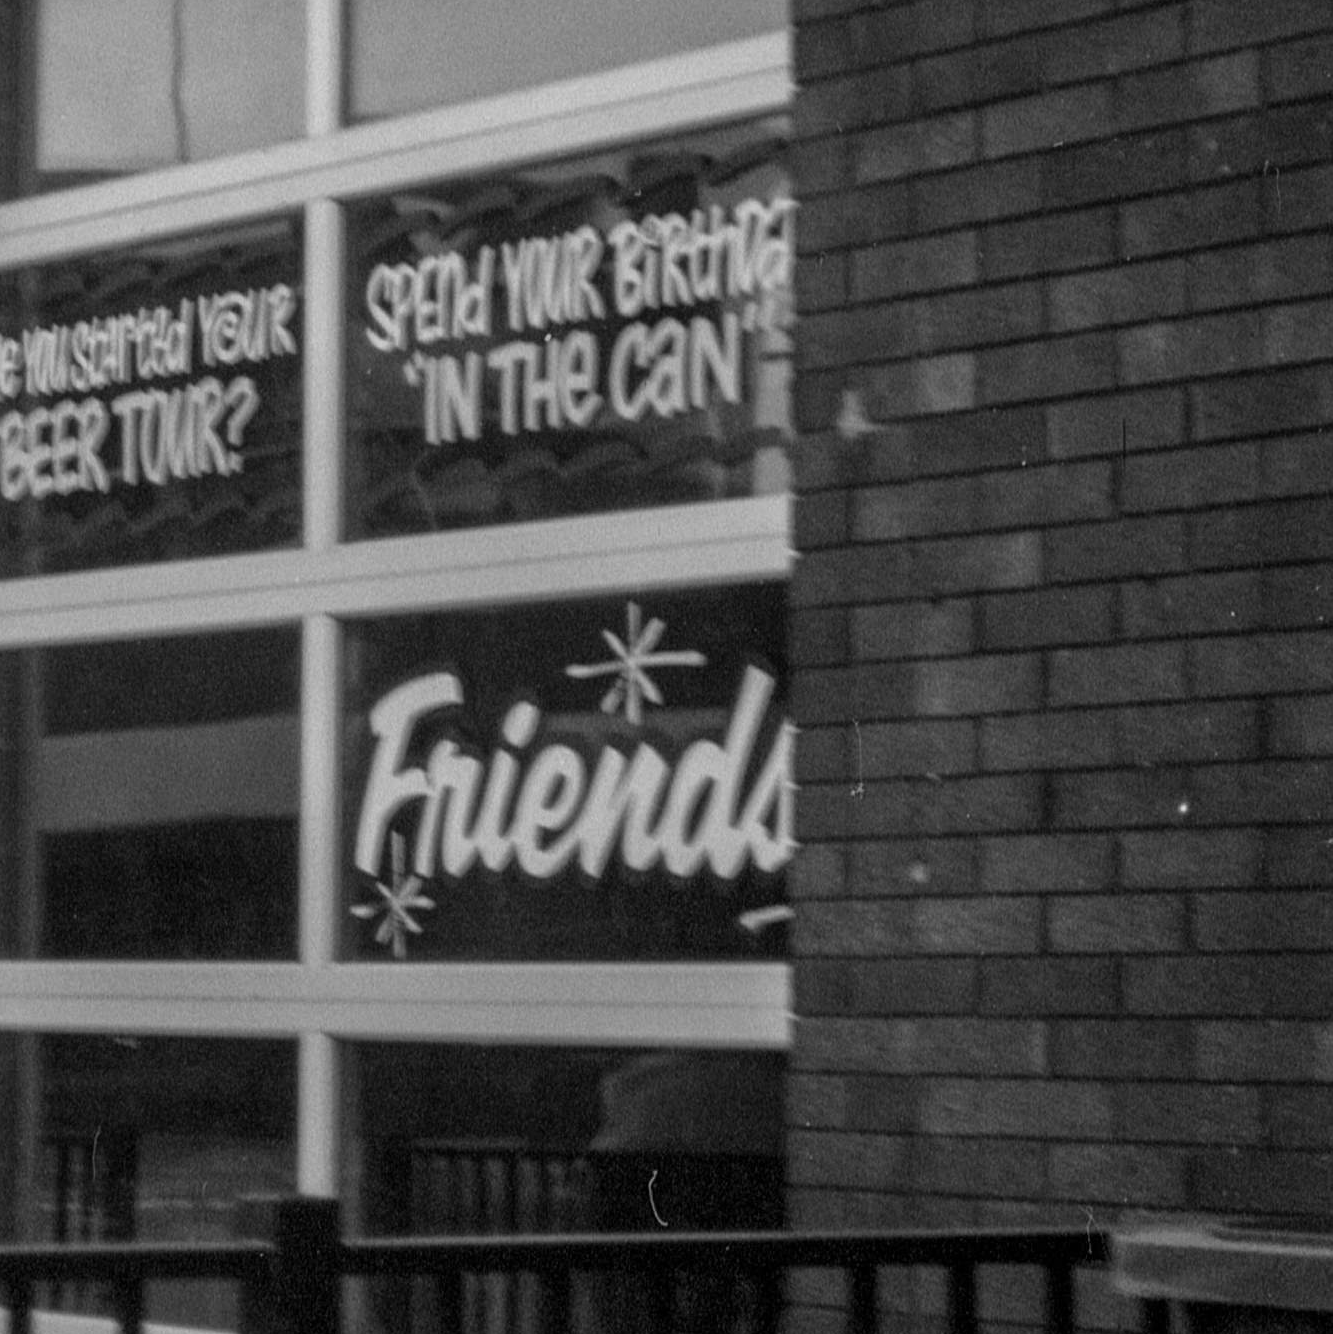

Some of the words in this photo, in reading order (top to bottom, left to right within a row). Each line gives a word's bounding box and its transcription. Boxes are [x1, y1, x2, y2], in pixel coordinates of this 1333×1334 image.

[501, 225, 605, 332] YOUR
[112, 376, 259, 485] TOUR?
[354, 664, 796, 879] Friends
